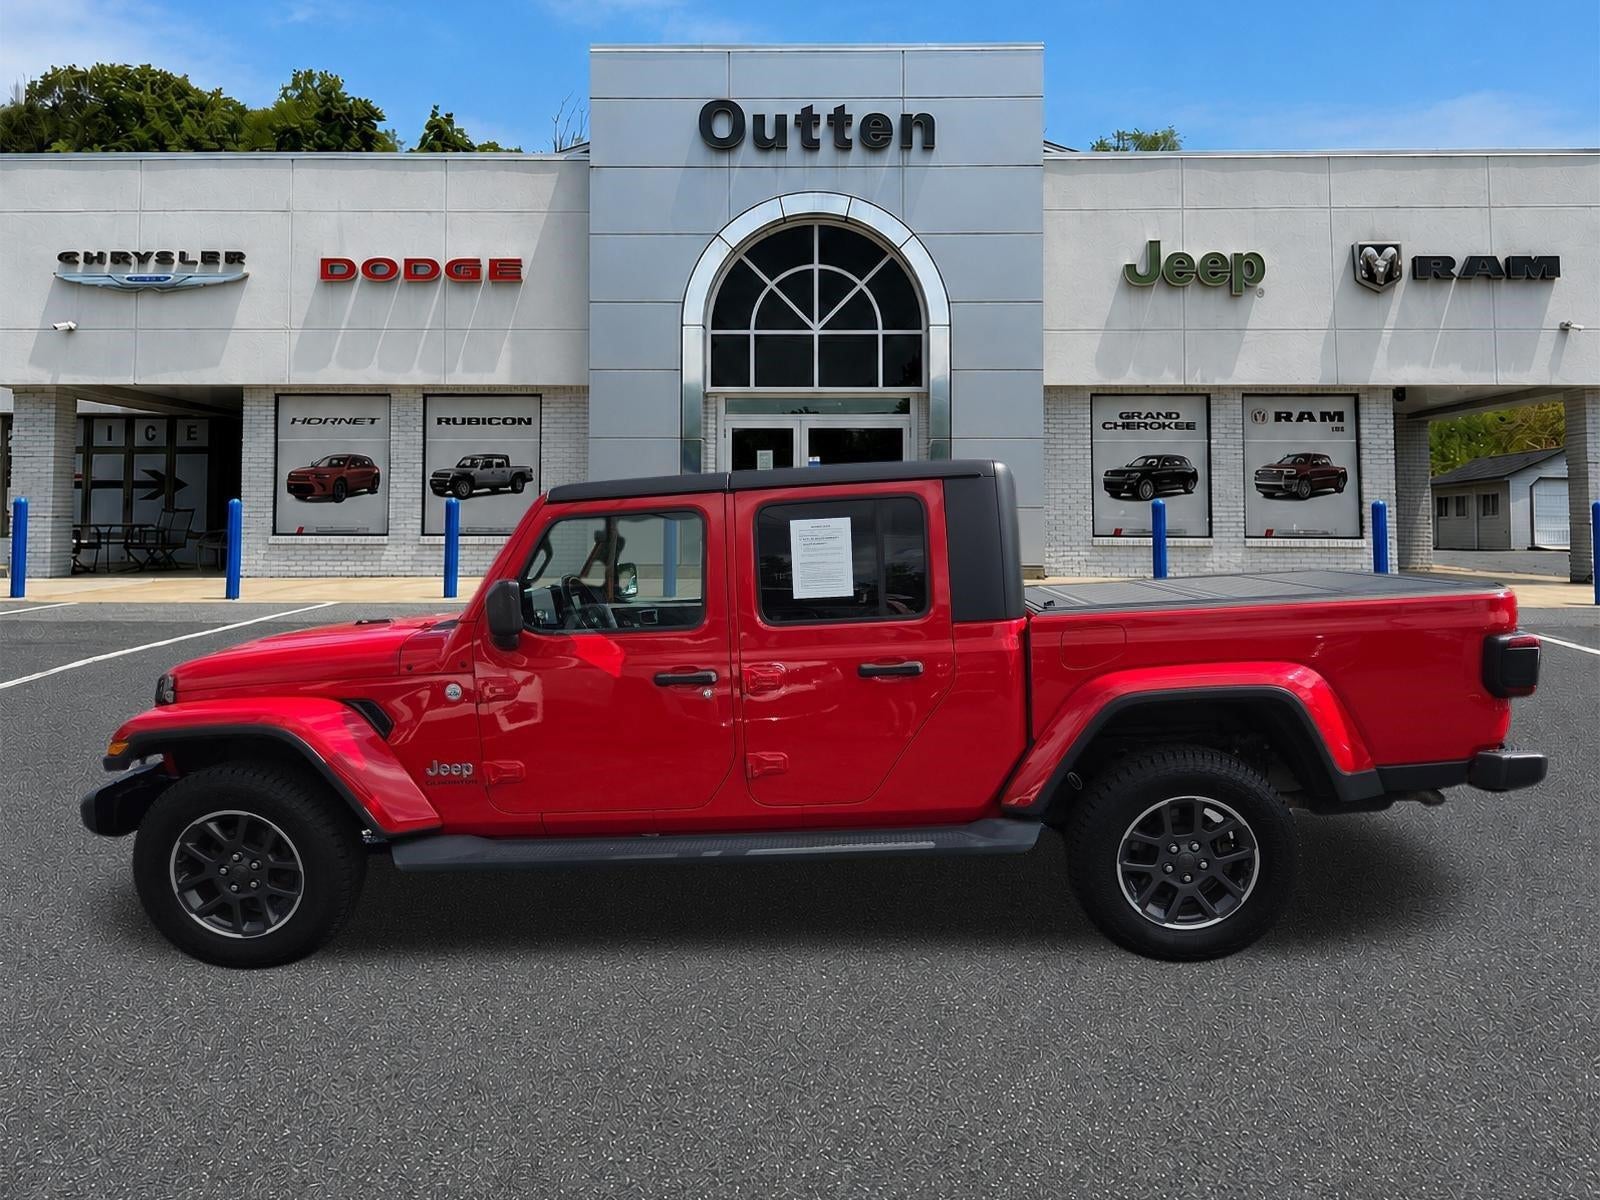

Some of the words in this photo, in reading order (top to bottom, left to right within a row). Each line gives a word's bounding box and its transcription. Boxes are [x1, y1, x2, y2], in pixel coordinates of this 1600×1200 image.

[699, 99, 936, 150] Outten
[56, 251, 247, 265] CHRYSLER
[320, 257, 523, 282] DODGE
[1123, 240, 1266, 296] Jeep
[1411, 255, 1561, 280] RAM
[290, 417, 381, 426] HORNET
[436, 416, 533, 426] RUBICON
[1118, 411, 1180, 421] GRAND
[1274, 410, 1345, 423] RAM
[1101, 421, 1197, 431] CHEROKEE
[425, 759, 473, 778] Jeep
